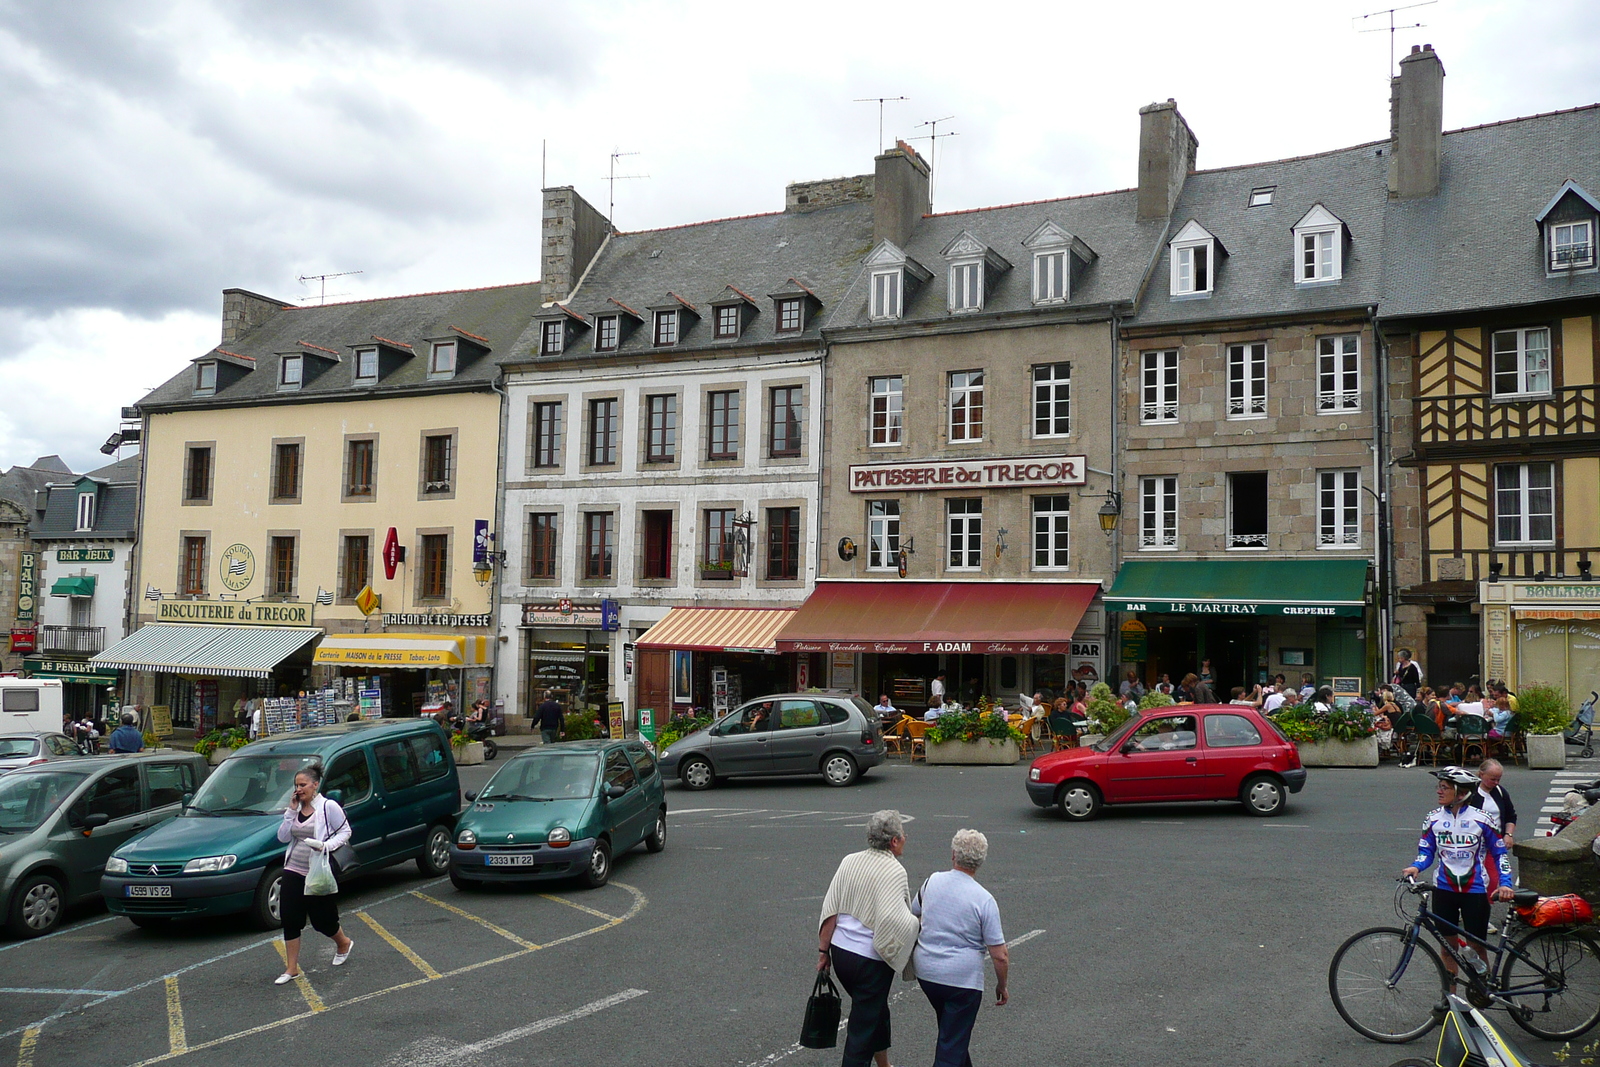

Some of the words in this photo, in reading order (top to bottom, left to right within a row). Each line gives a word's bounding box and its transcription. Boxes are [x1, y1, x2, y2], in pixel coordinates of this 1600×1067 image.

[854, 466, 954, 487] PATISSERIE
[955, 466, 982, 483] du
[983, 461, 1078, 482] TREGOR
[59, 550, 80, 560] BAR
[85, 550, 111, 560] JEUX
[224, 544, 252, 560] KOUIGN
[21, 554, 34, 596] BAR
[223, 575, 250, 589] AMANN
[160, 603, 235, 619] BISCUITERIE
[238, 607, 252, 621] du
[255, 606, 307, 622] TREGOR
[1126, 603, 1147, 611] BAR
[1170, 603, 1186, 612] LE
[1191, 603, 1258, 614] MARTRAY
[1282, 606, 1336, 615] CREPERIE
[1525, 610, 1575, 618] PATISSERIE
[18, 611, 33, 619] JEUX
[383, 613, 420, 626] MAISON
[451, 614, 489, 628] PRESSE
[1524, 630, 1541, 641] La
[828, 642, 867, 651] Chocolatier
[874, 643, 908, 654] Confiseur
[923, 643, 934, 652] F.
[936, 642, 971, 652] ADAM
[987, 642, 1013, 652] Salon
[1019, 644, 1030, 652] de
[1036, 644, 1049, 652] thé
[1071, 644, 1099, 656] BAR
[319, 651, 340, 659] Carterie
[345, 652, 367, 661] MAISON
[376, 653, 383, 661] la
[384, 653, 403, 661] PRESSE
[41, 661, 53, 672] LE
[1437, 834, 1474, 845] ITALIA
[489, 856, 509, 865] 2333
[510, 856, 520, 865] WT
[521, 855, 532, 865] 22
[130, 886, 148, 896] 4599
[149, 886, 159, 896] VS
[160, 886, 170, 896] 22
[1482, 1023, 1499, 1046] GILERA
